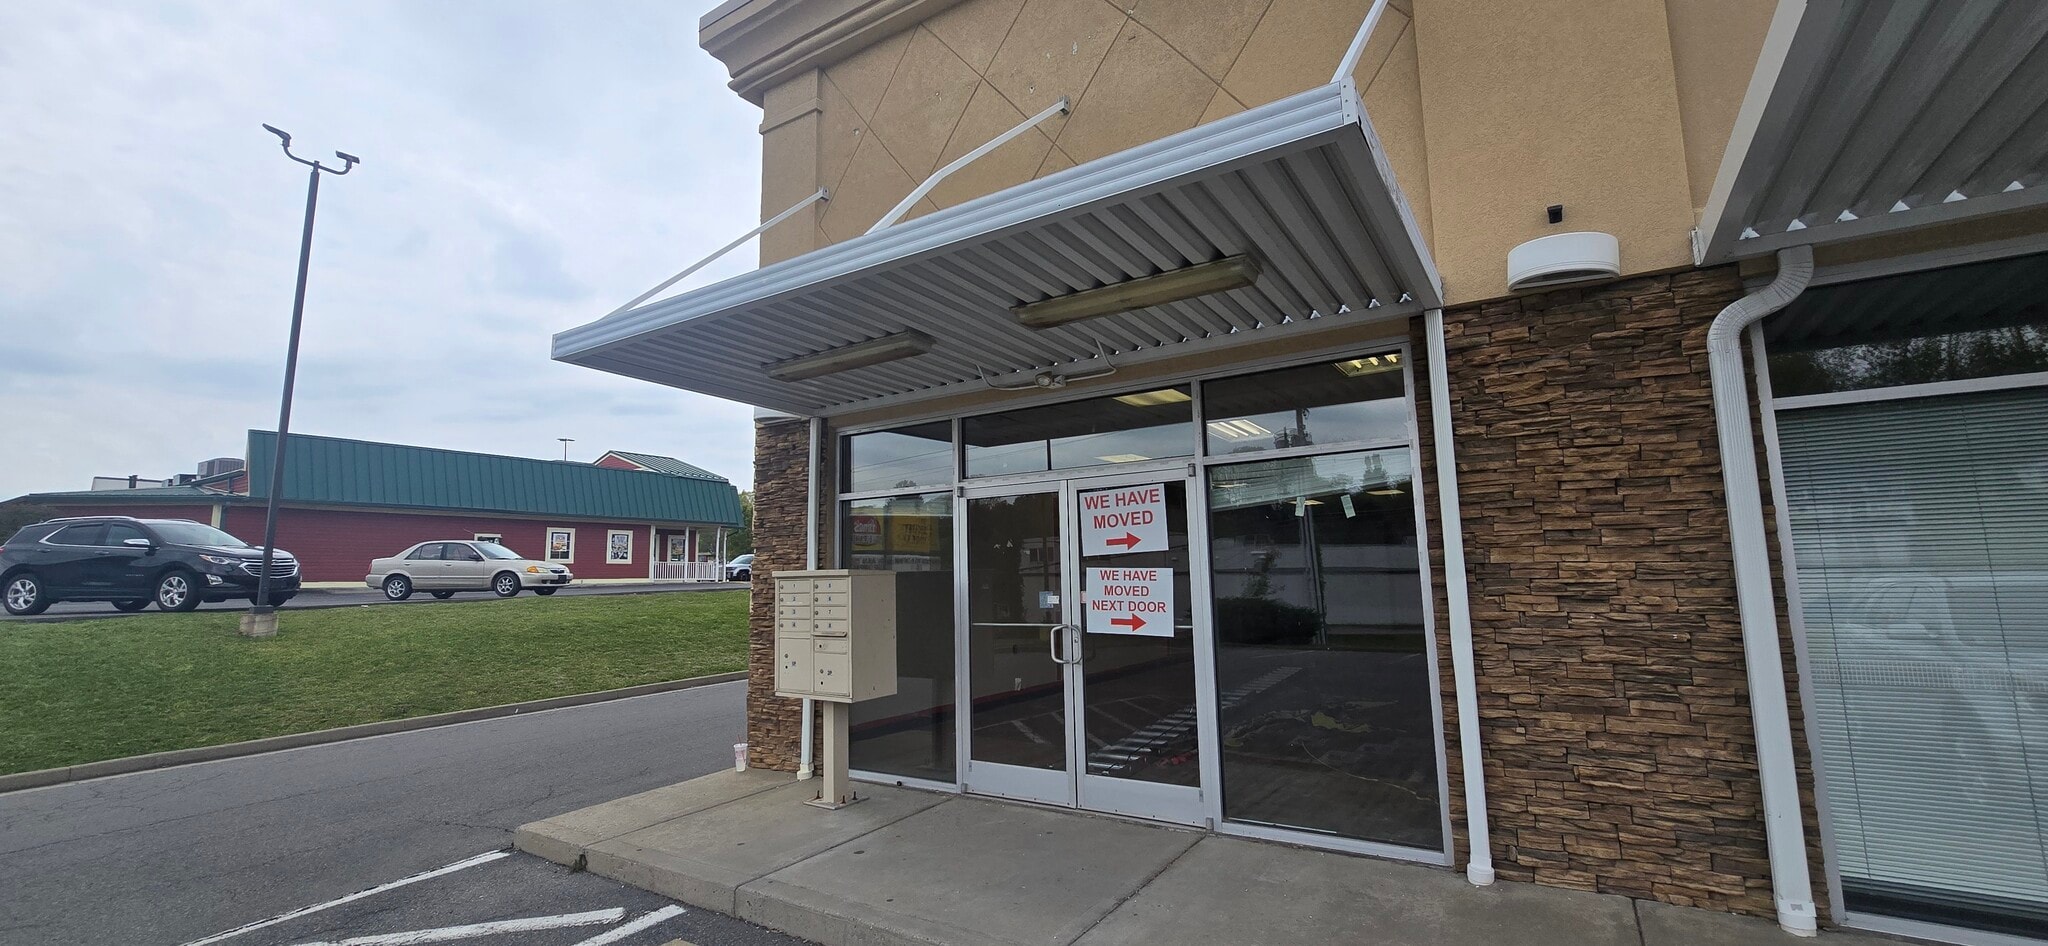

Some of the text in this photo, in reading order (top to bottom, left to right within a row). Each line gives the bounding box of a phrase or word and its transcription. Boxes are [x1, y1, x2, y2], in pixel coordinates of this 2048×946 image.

[1084, 488, 1160, 510] WE HAVE
[1093, 510, 1154, 529] MOVED
[1099, 570, 1157, 581] WE HAVE
[1103, 585, 1150, 596] MOVED
[1091, 600, 1167, 613] NEXT DOOR
